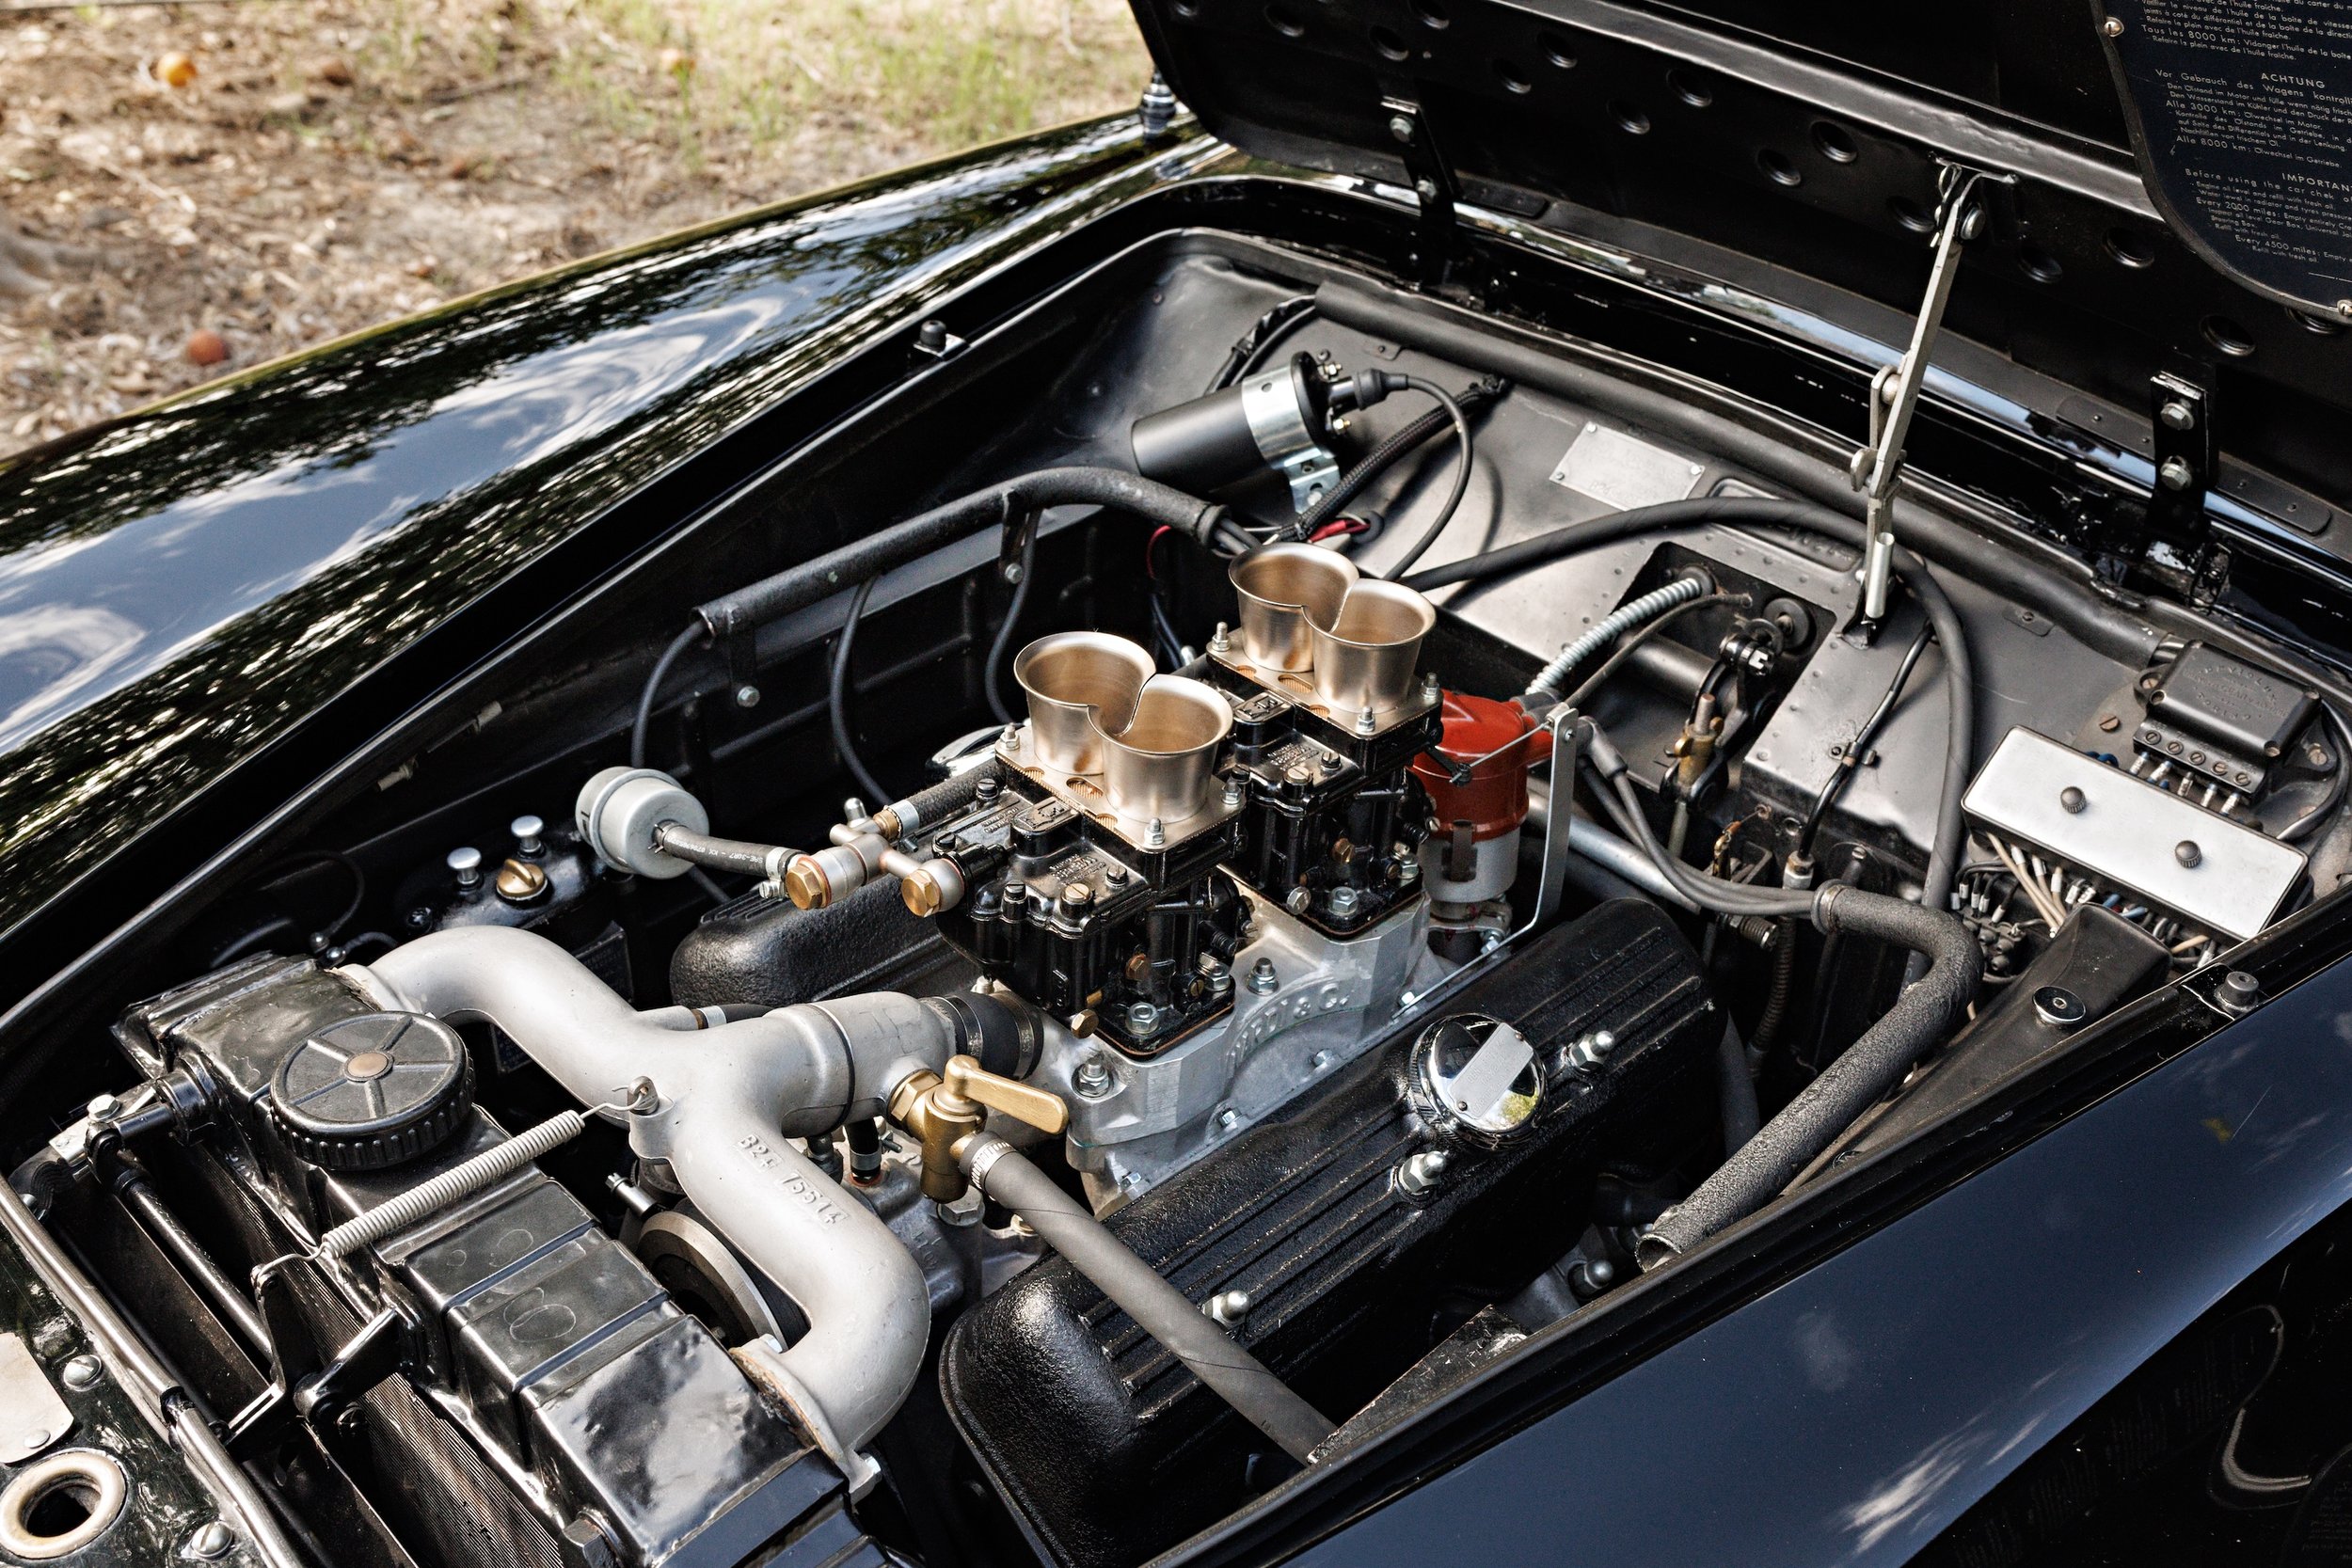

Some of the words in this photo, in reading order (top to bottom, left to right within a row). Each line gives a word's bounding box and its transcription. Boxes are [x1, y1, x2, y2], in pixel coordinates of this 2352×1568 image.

[2183, 3, 2206, 11] niveau
[2146, 16, 2171, 24] Refaire
[2141, 24, 2164, 34] Tous
[2168, 27, 2183, 37] les
[2187, 30, 2216, 40] 8000
[2243, 38, 2279, 50] Vidanger
[2307, 46, 2317, 55] de
[2152, 35, 2177, 44] Refaire
[2155, 69, 2171, 77] Vor
[2181, 72, 2227, 86] Gebrauch
[2236, 80, 2253, 90] des
[2262, 84, 2303, 98] Wagens
[2261, 72, 2325, 88] ACHTUNG
[2166, 98, 2185, 108] Alle
[2190, 102, 2217, 113] 3000
[2186, 93, 2233, 105] Wasserstand
[2247, 103, 2270, 111] Kühler
[2307, 111, 2328, 120] Druck
[2227, 91, 2249, 100] Motor
[2311, 104, 2329, 113] nötig
[2176, 133, 2195, 143] Alle
[2201, 136, 2227, 149] 8000
[2236, 135, 2265, 144] frischem
[2185, 167, 2220, 181] Before
[2228, 177, 2257, 187] using
[2263, 181, 2280, 189] the
[2196, 181, 2219, 189] Engine
[2196, 197, 2220, 208] Every
[2225, 201, 2249, 212] 2000
[2283, 212, 2306, 223] Empty
[2253, 199, 2281, 208] radiator
[2305, 225, 2338, 235] Universal
[2234, 234, 2260, 245] Every
[2265, 240, 2289, 250] 4500
[2323, 250, 2345, 262] Empty
[2288, 252, 2305, 261] fresh
